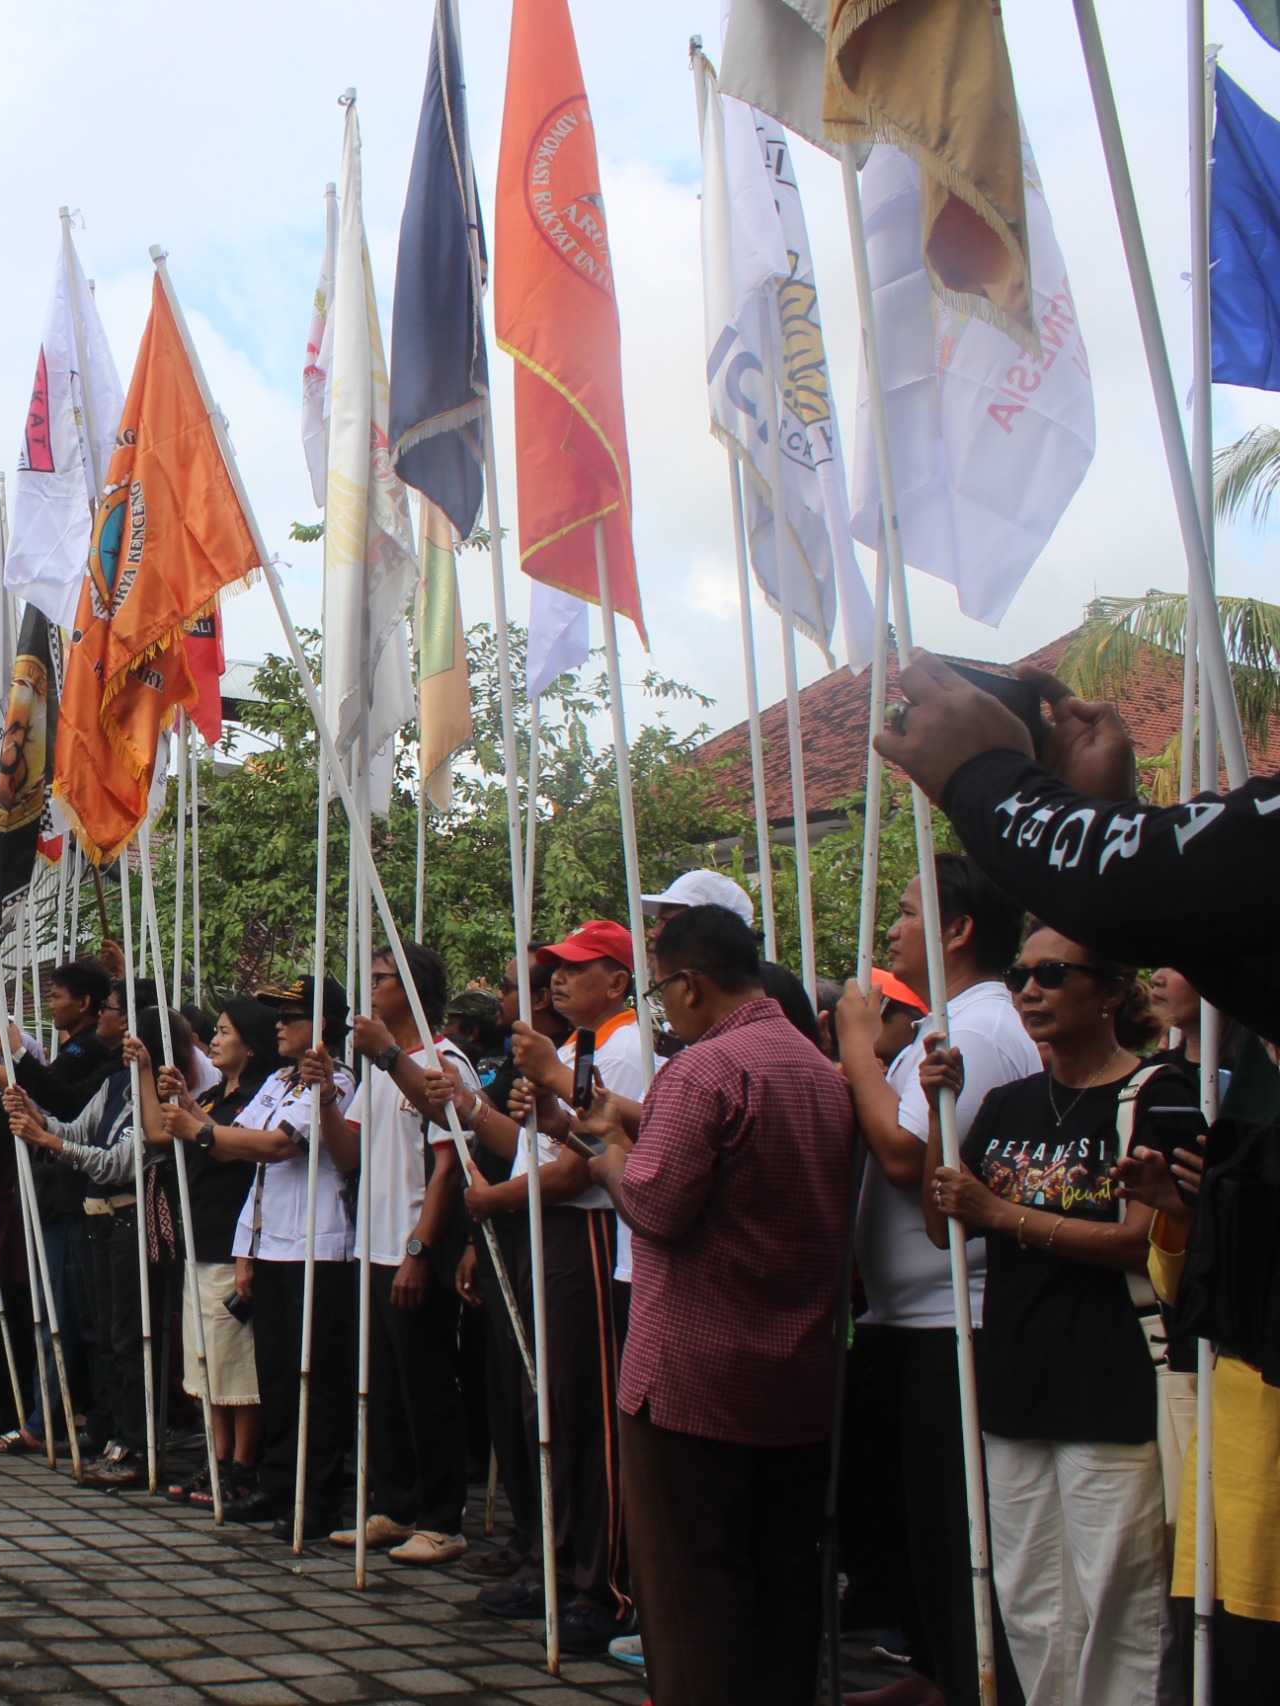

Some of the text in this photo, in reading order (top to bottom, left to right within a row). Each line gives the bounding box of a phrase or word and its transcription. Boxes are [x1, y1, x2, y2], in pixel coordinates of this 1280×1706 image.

[532, 110, 578, 185] ADVOKASI
[533, 191, 579, 253] RAKYAT
[126, 480, 147, 566] KENCENG
